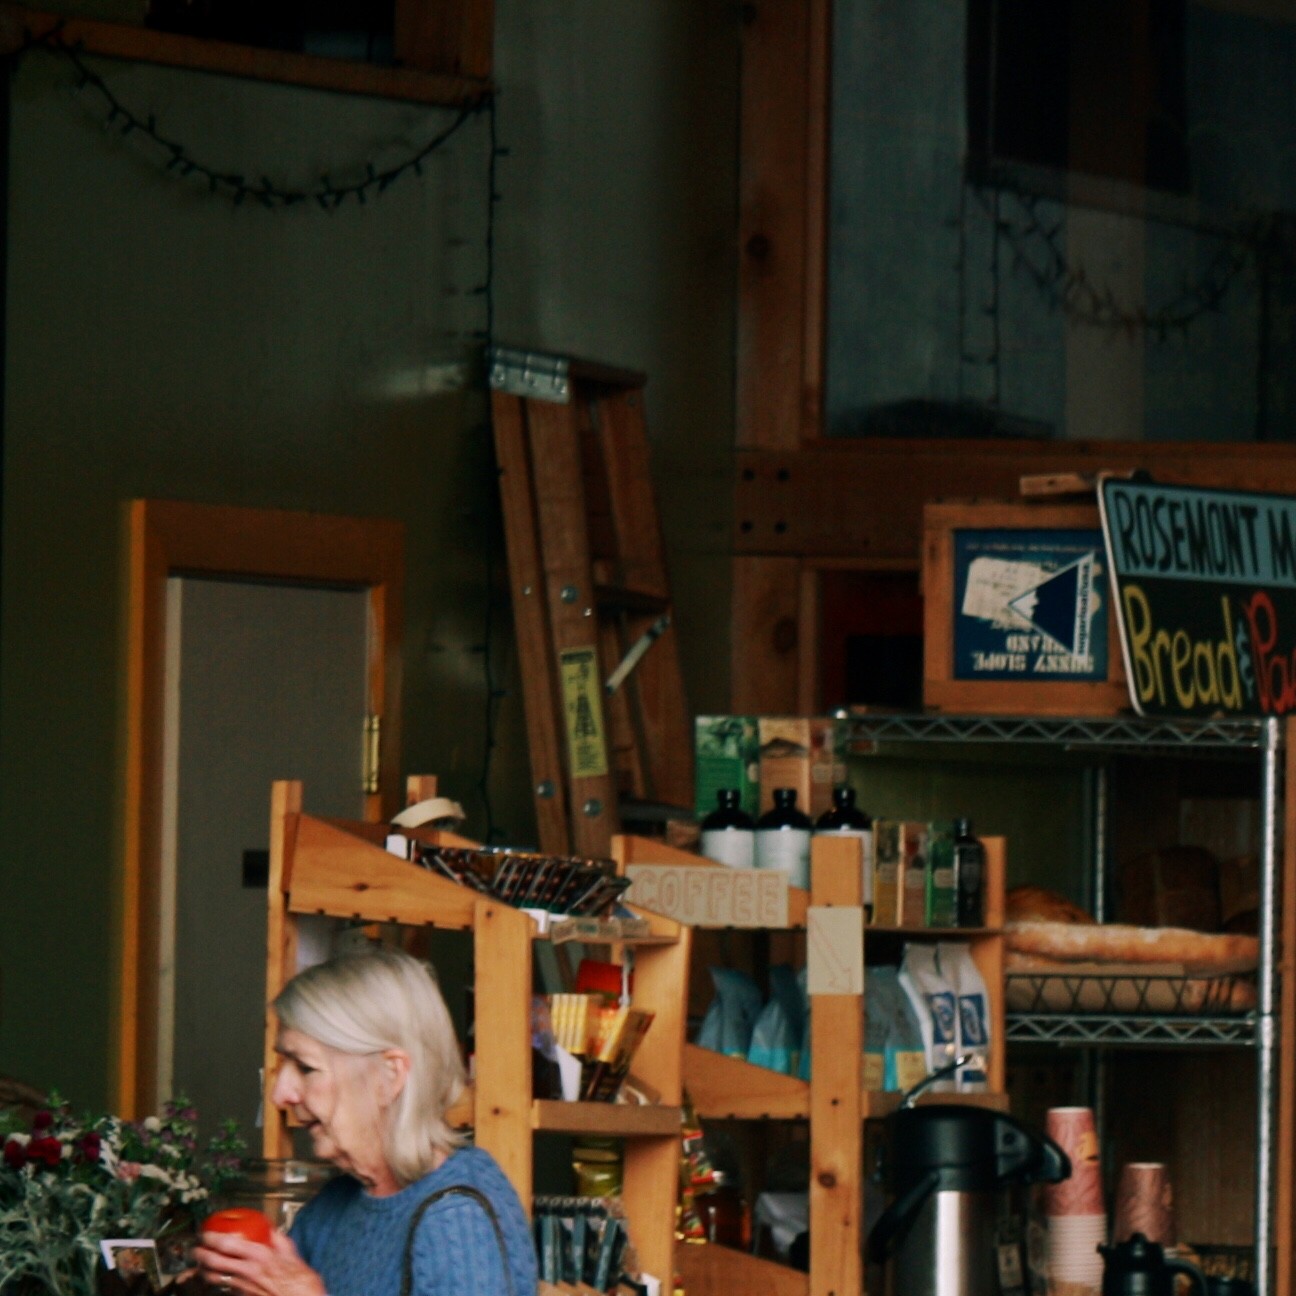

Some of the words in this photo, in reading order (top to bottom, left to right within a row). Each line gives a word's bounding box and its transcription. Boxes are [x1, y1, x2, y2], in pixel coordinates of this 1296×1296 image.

[1114, 488, 1264, 576] ROSEMONT
[1122, 583, 1242, 711] Bread
[631, 868, 781, 922] COFFEE
